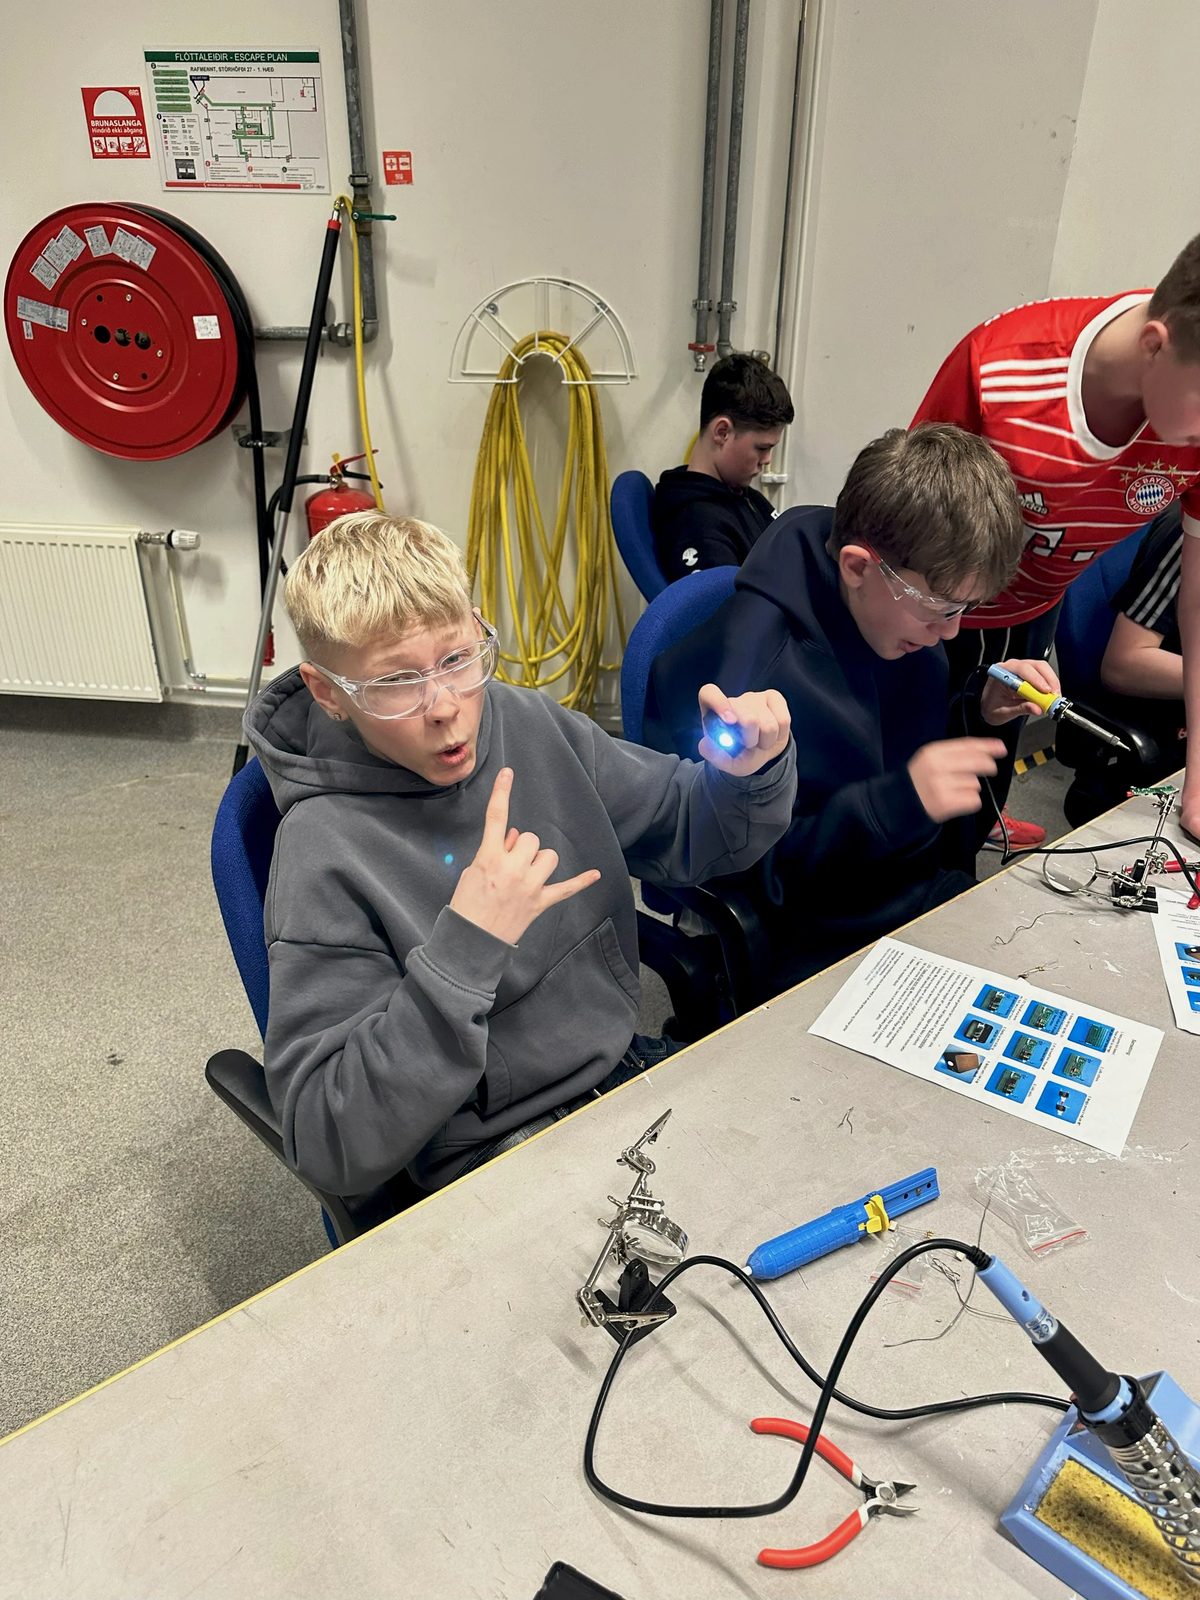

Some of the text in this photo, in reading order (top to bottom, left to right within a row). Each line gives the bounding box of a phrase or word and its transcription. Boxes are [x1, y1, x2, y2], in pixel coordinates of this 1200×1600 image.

[174, 52, 229, 61] FLÓTTALEIÐIR
[234, 53, 266, 61] ESCAPE
[267, 53, 288, 61] PLAN
[124, 127, 143, 135] aðgang
[1130, 477, 1172, 493] FC BAYERN
